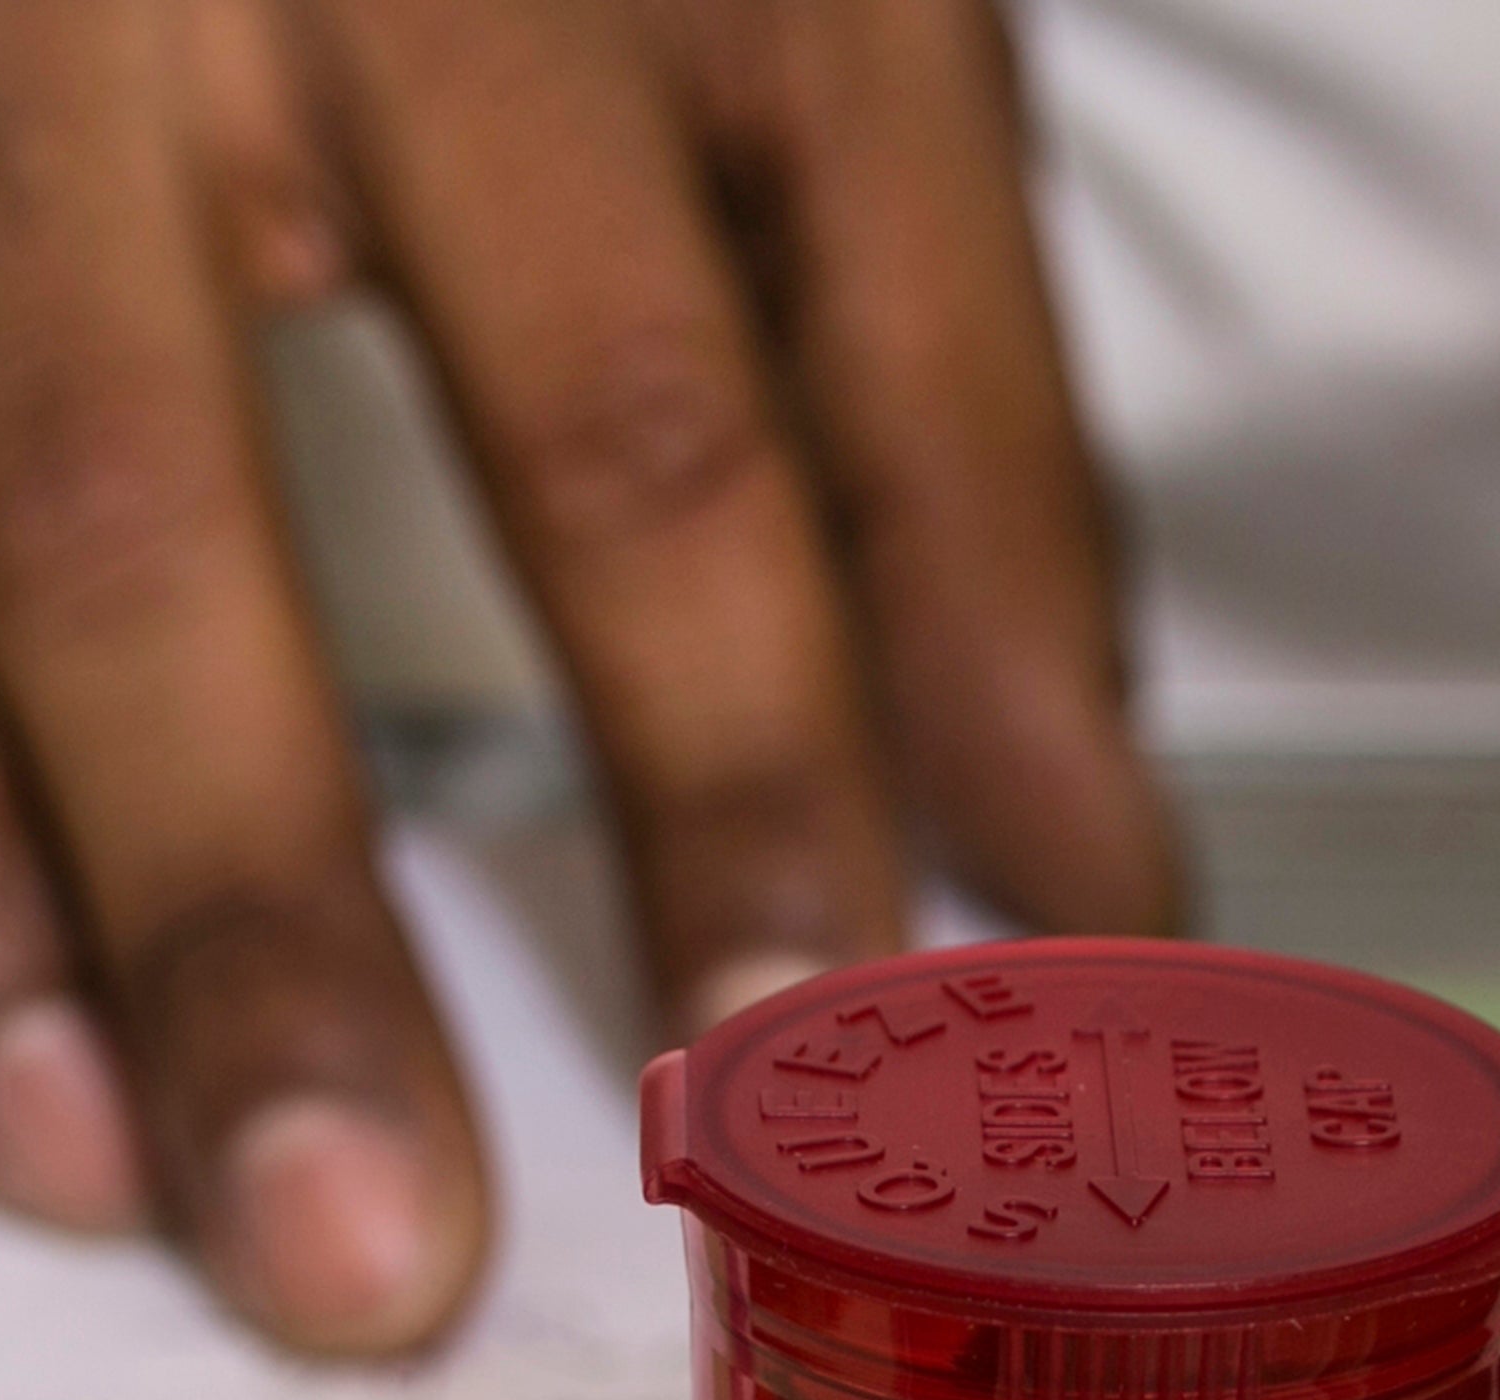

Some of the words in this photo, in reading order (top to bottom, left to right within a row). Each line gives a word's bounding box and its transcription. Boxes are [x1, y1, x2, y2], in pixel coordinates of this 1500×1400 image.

[760, 972, 1062, 1243] SQUEEZE
[974, 1046, 1080, 1170] SIDES
[1170, 1038, 1276, 1182] BELOW
[1304, 1064, 1402, 1150] CAP
